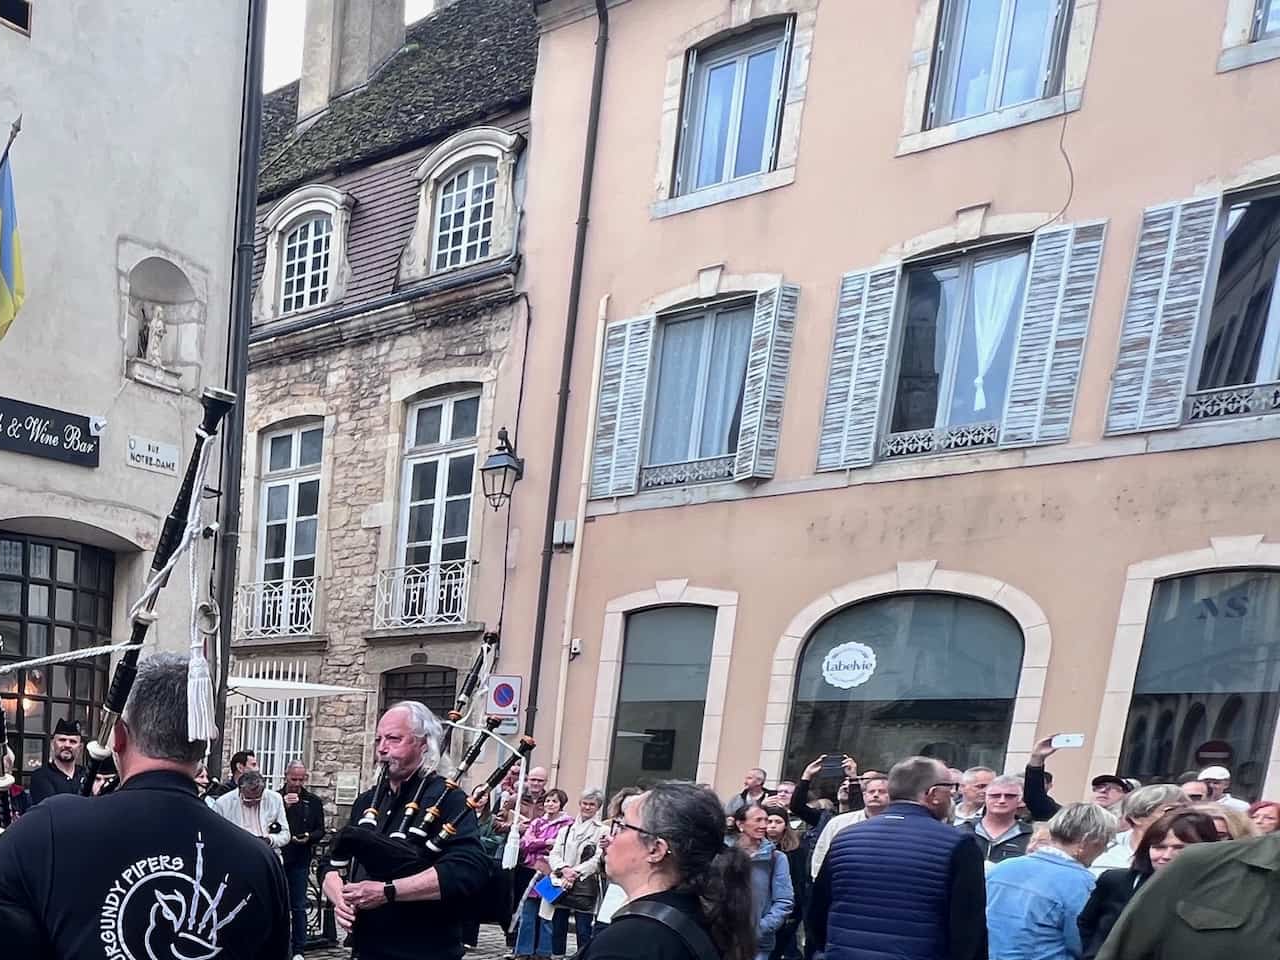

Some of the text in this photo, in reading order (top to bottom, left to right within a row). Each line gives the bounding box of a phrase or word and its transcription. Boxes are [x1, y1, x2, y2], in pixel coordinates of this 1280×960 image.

[6, 417, 23, 440] &
[24, 415, 60, 448] Wine
[63, 423, 96, 454] Bar
[130, 451, 176, 472] NOTRE-DAME
[121, 853, 185, 885] PIPERS
